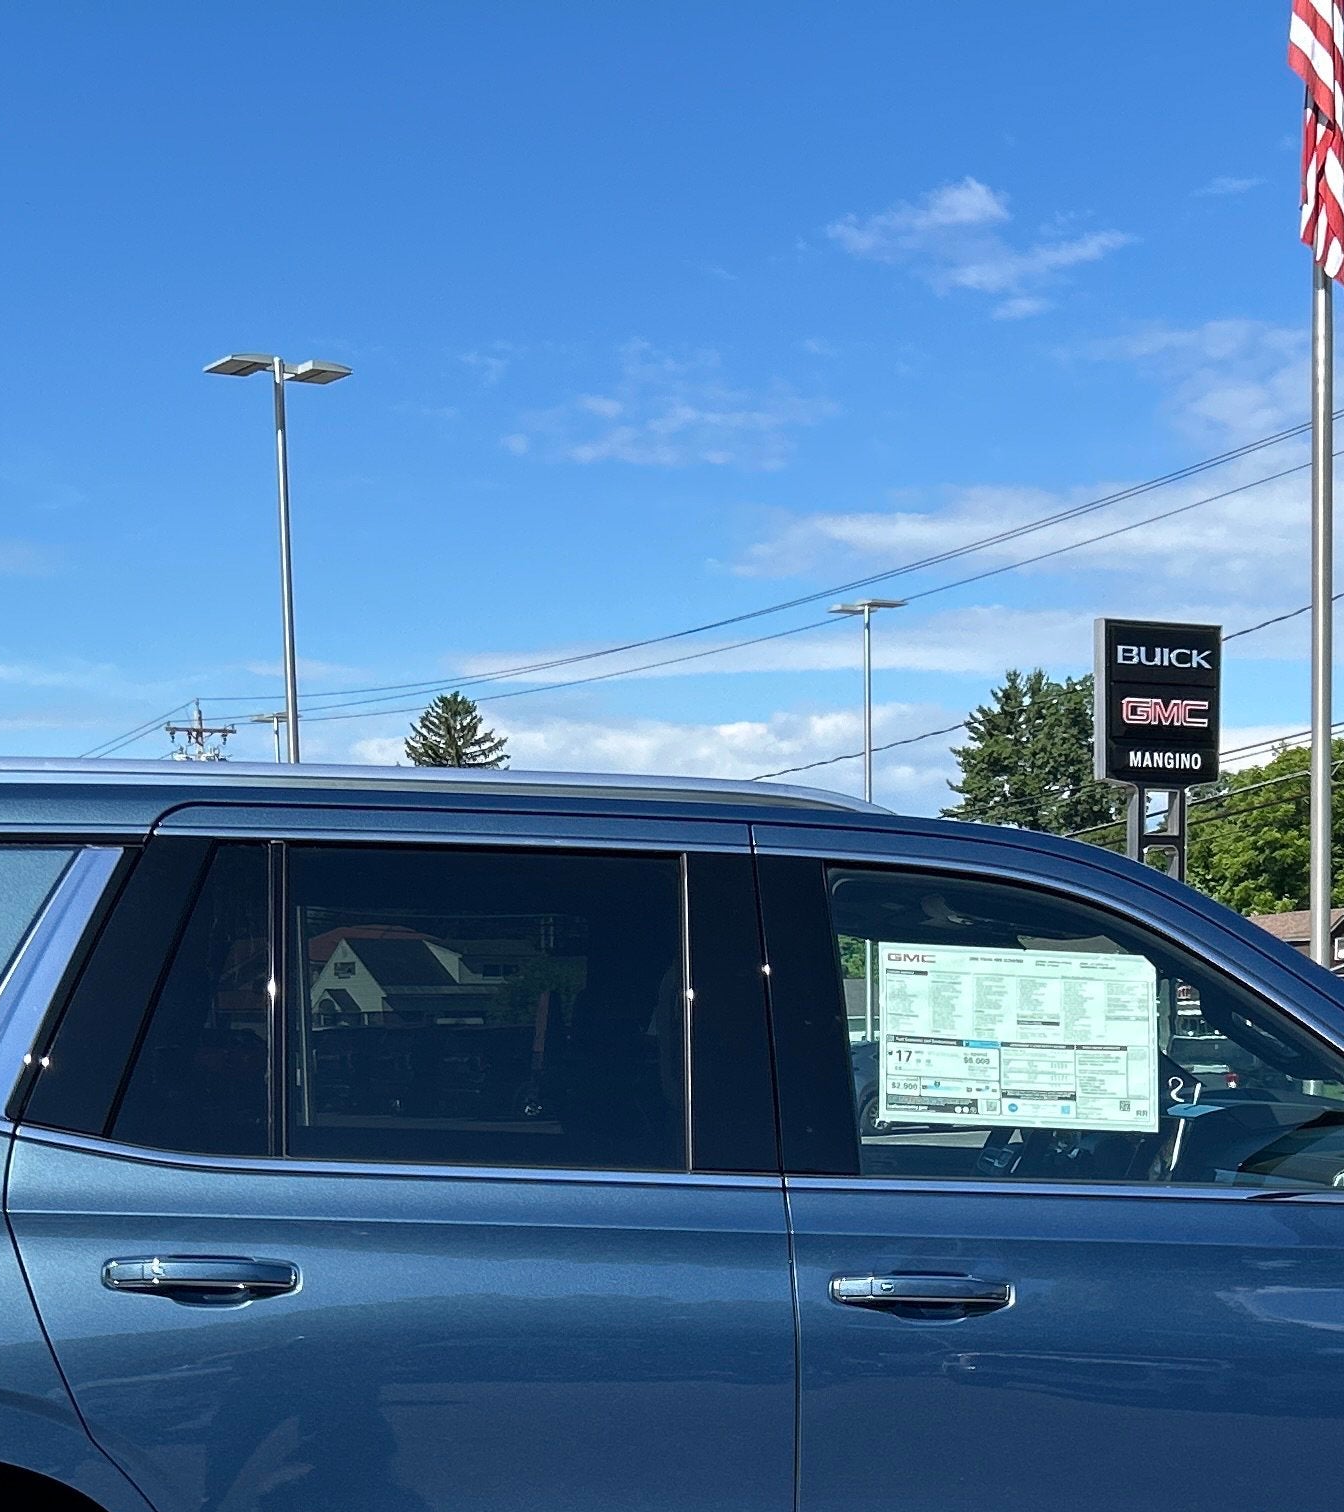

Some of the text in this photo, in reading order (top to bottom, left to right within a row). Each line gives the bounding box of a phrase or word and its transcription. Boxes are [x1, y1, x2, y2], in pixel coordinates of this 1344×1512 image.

[1117, 645, 1212, 669] BUICK
[1122, 697, 1208, 727] GMC
[1129, 751, 1202, 769] MANGINO
[887, 953, 936, 963] GMC
[896, 1050, 912, 1062] 17
